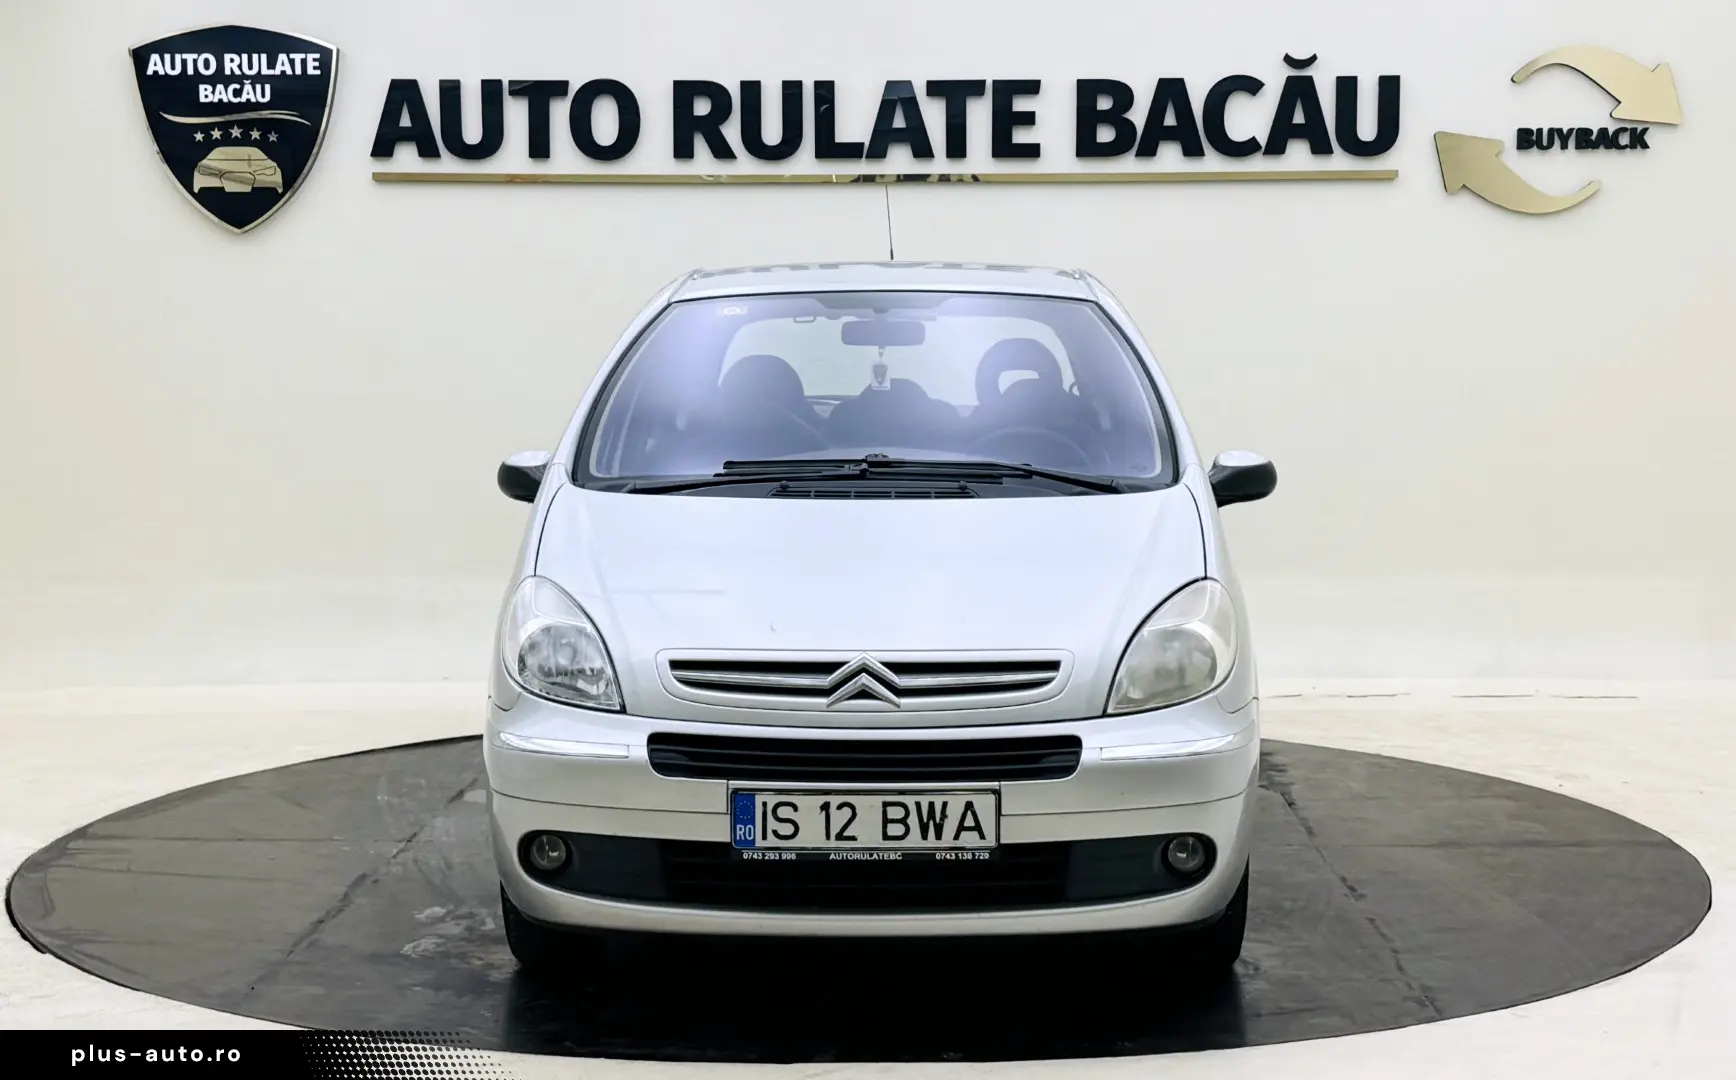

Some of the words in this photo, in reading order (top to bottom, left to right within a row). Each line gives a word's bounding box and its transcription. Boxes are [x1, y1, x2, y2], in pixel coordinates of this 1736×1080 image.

[146, 53, 217, 76] AUTO
[223, 53, 321, 76] RULATE
[198, 79, 271, 103] BACĂU
[370, 78, 641, 161] AUTO
[672, 78, 1042, 161] RULATE
[1075, 52, 1401, 159] BACĂU
[1516, 126, 1650, 151] BUYBACK
[736, 824, 754, 841] RO
[761, 800, 800, 841] IS
[819, 800, 858, 841] 12
[881, 800, 987, 842] BWA
[742, 852, 763, 860] 0743
[829, 852, 903, 861] AUTORULATEBC
